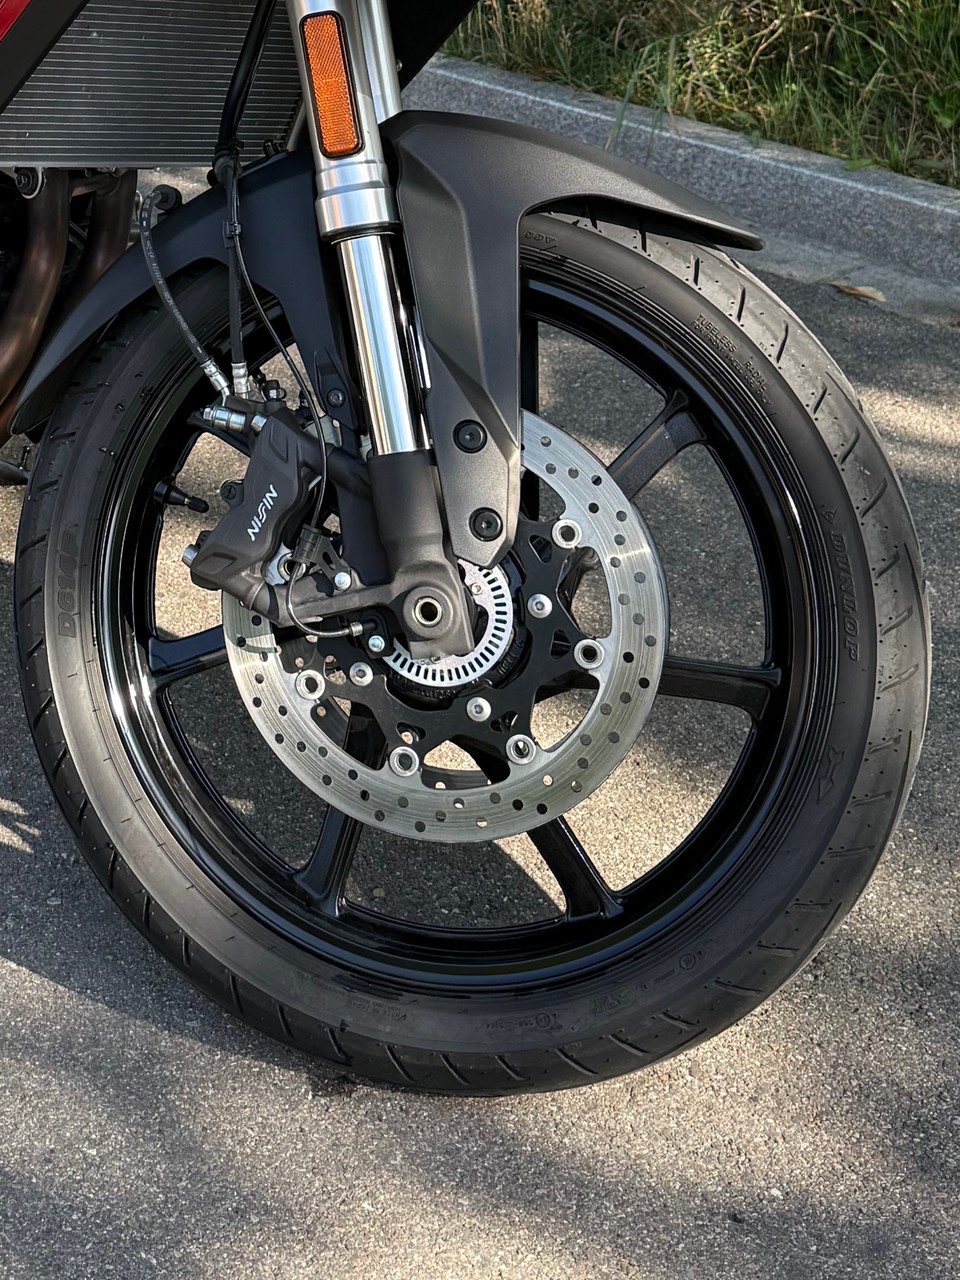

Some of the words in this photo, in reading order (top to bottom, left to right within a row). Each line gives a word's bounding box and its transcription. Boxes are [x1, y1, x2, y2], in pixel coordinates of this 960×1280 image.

[697, 313, 737, 353] TUBELESS
[742, 360, 768, 392] RADIAL
[830, 530, 860, 662] DUNLOP
